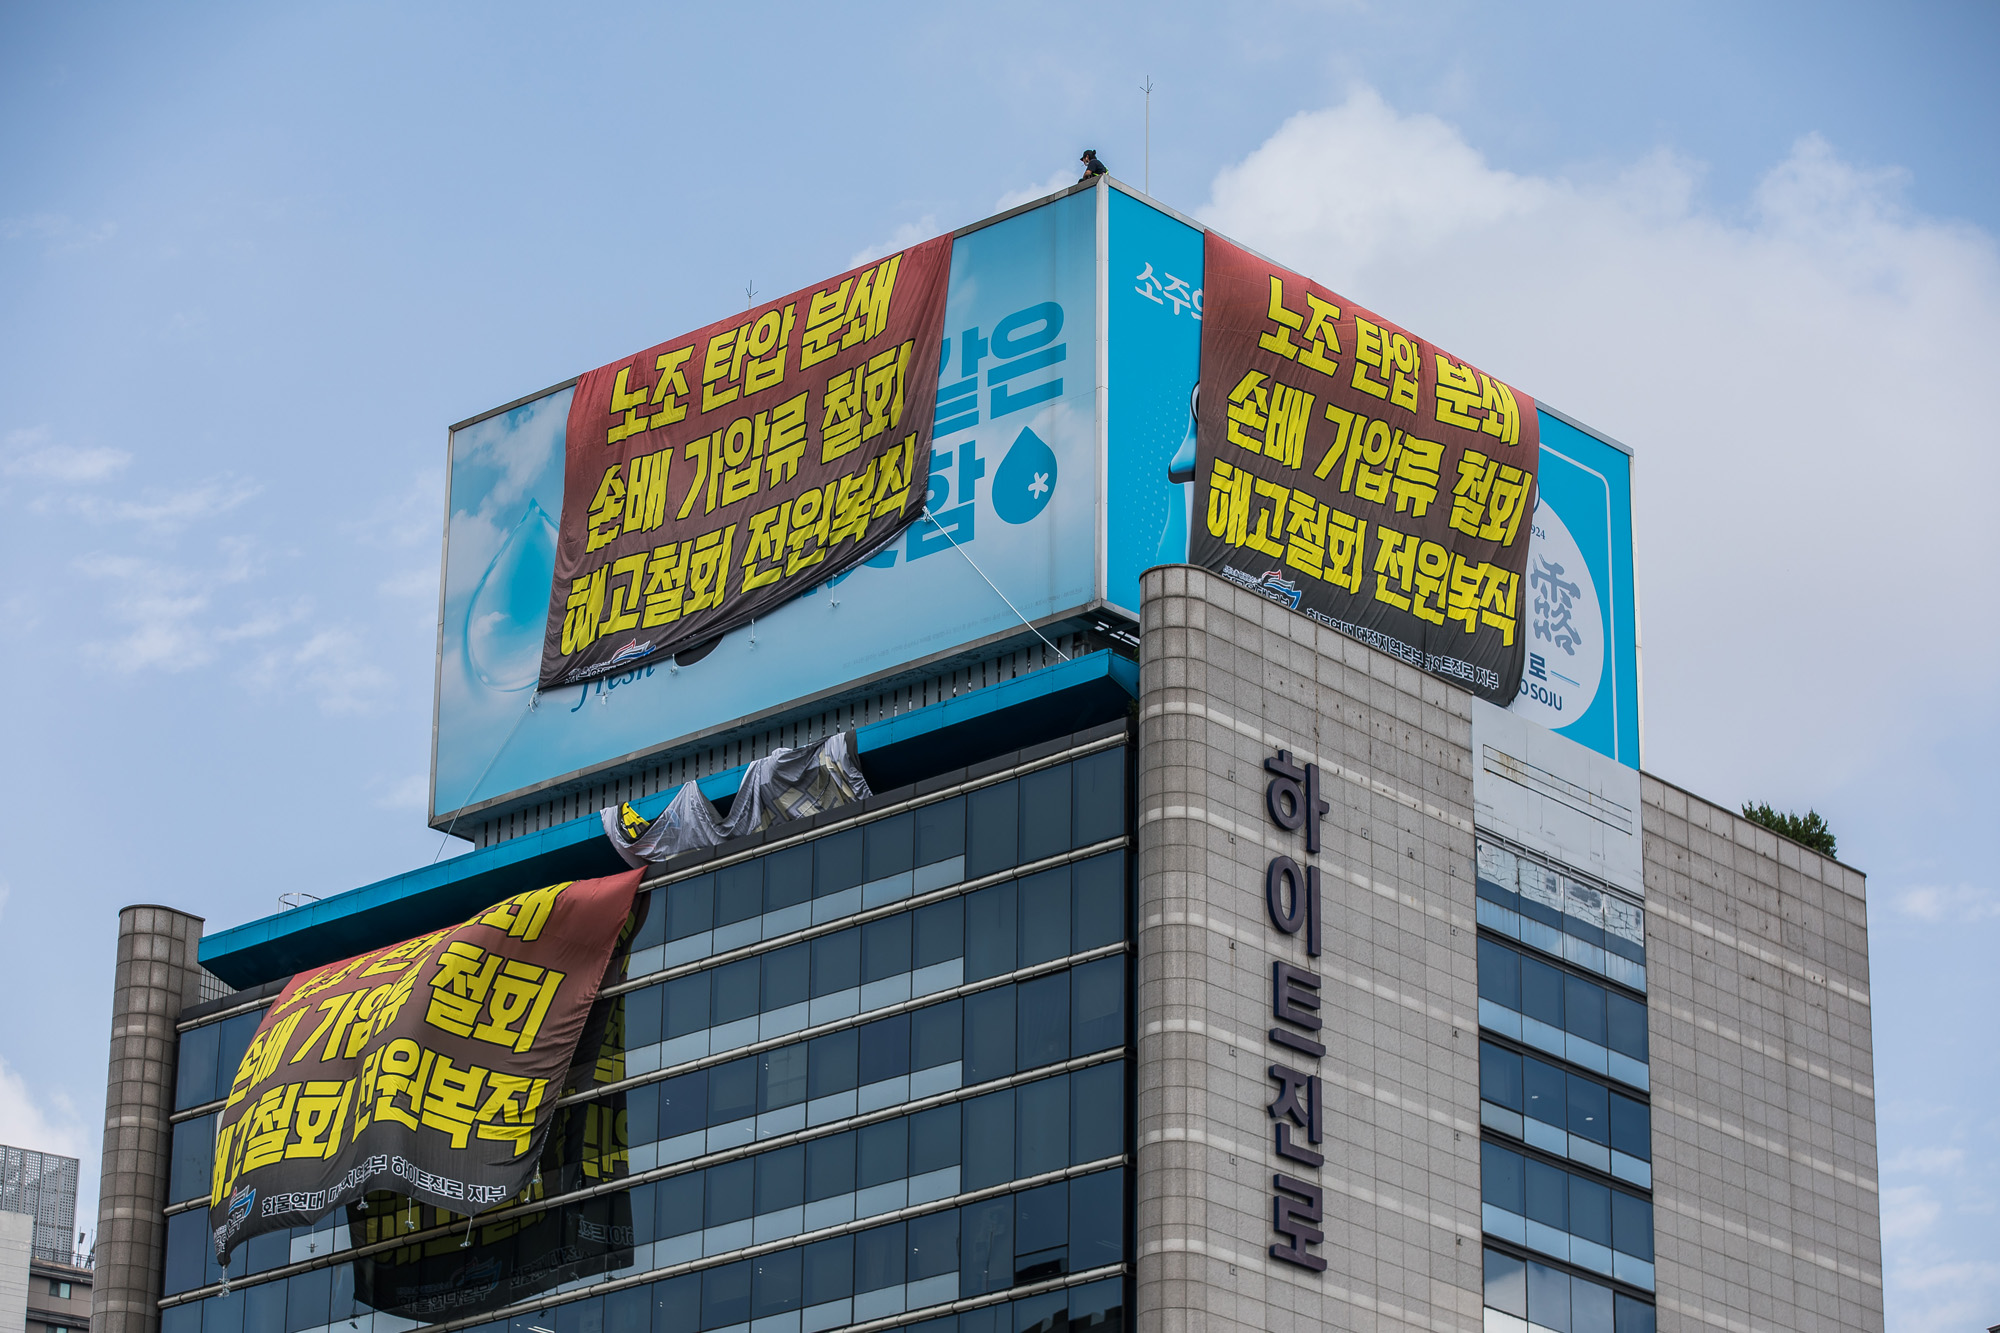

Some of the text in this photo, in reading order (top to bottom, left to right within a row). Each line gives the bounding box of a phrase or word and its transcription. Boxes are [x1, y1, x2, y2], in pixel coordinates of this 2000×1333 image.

[607, 253, 903, 445] 노조 탄압 분쇄
[1257, 274, 1521, 446] 노조 탄압 분쇄
[586, 448, 673, 554] 손배
[676, 391, 808, 522] 가압류
[819, 339, 915, 465] 철회
[1226, 370, 1533, 548] 손배 가압류 철회
[1531, 525, 1546, 540] 924
[560, 524, 733, 656] 해고철회
[740, 431, 918, 593] 전원복직
[1206, 457, 1521, 647] 해고철회 전원복직
[1476, 667, 1499, 690] 지부
[1529, 652, 1547, 681] 로
[1530, 683, 1562, 711] SOJU
[425, 941, 567, 1053] 철회
[1264, 748, 1329, 1272] 하이트진로
[262, 1190, 325, 1217] 화물연대
[391, 1155, 464, 1200] 하이트진로
[467, 1184, 507, 1204] 지부
